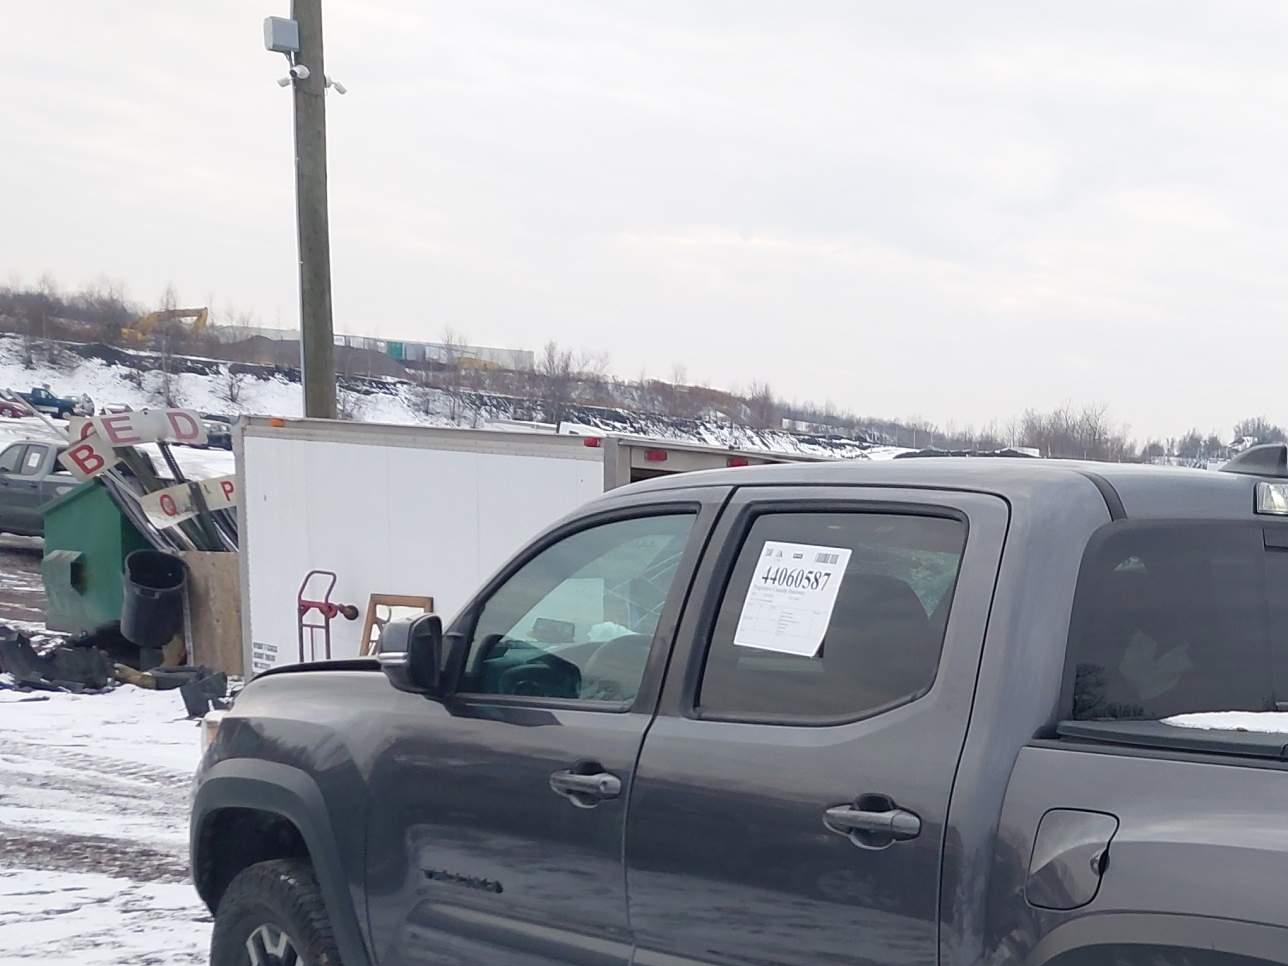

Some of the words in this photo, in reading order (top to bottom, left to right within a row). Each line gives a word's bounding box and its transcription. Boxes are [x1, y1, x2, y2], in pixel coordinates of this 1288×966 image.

[101, 415, 141, 443] E
[166, 411, 199, 441] D
[68, 443, 105, 475] B
[219, 480, 235, 501] P
[761, 565, 832, 592] 44060587
